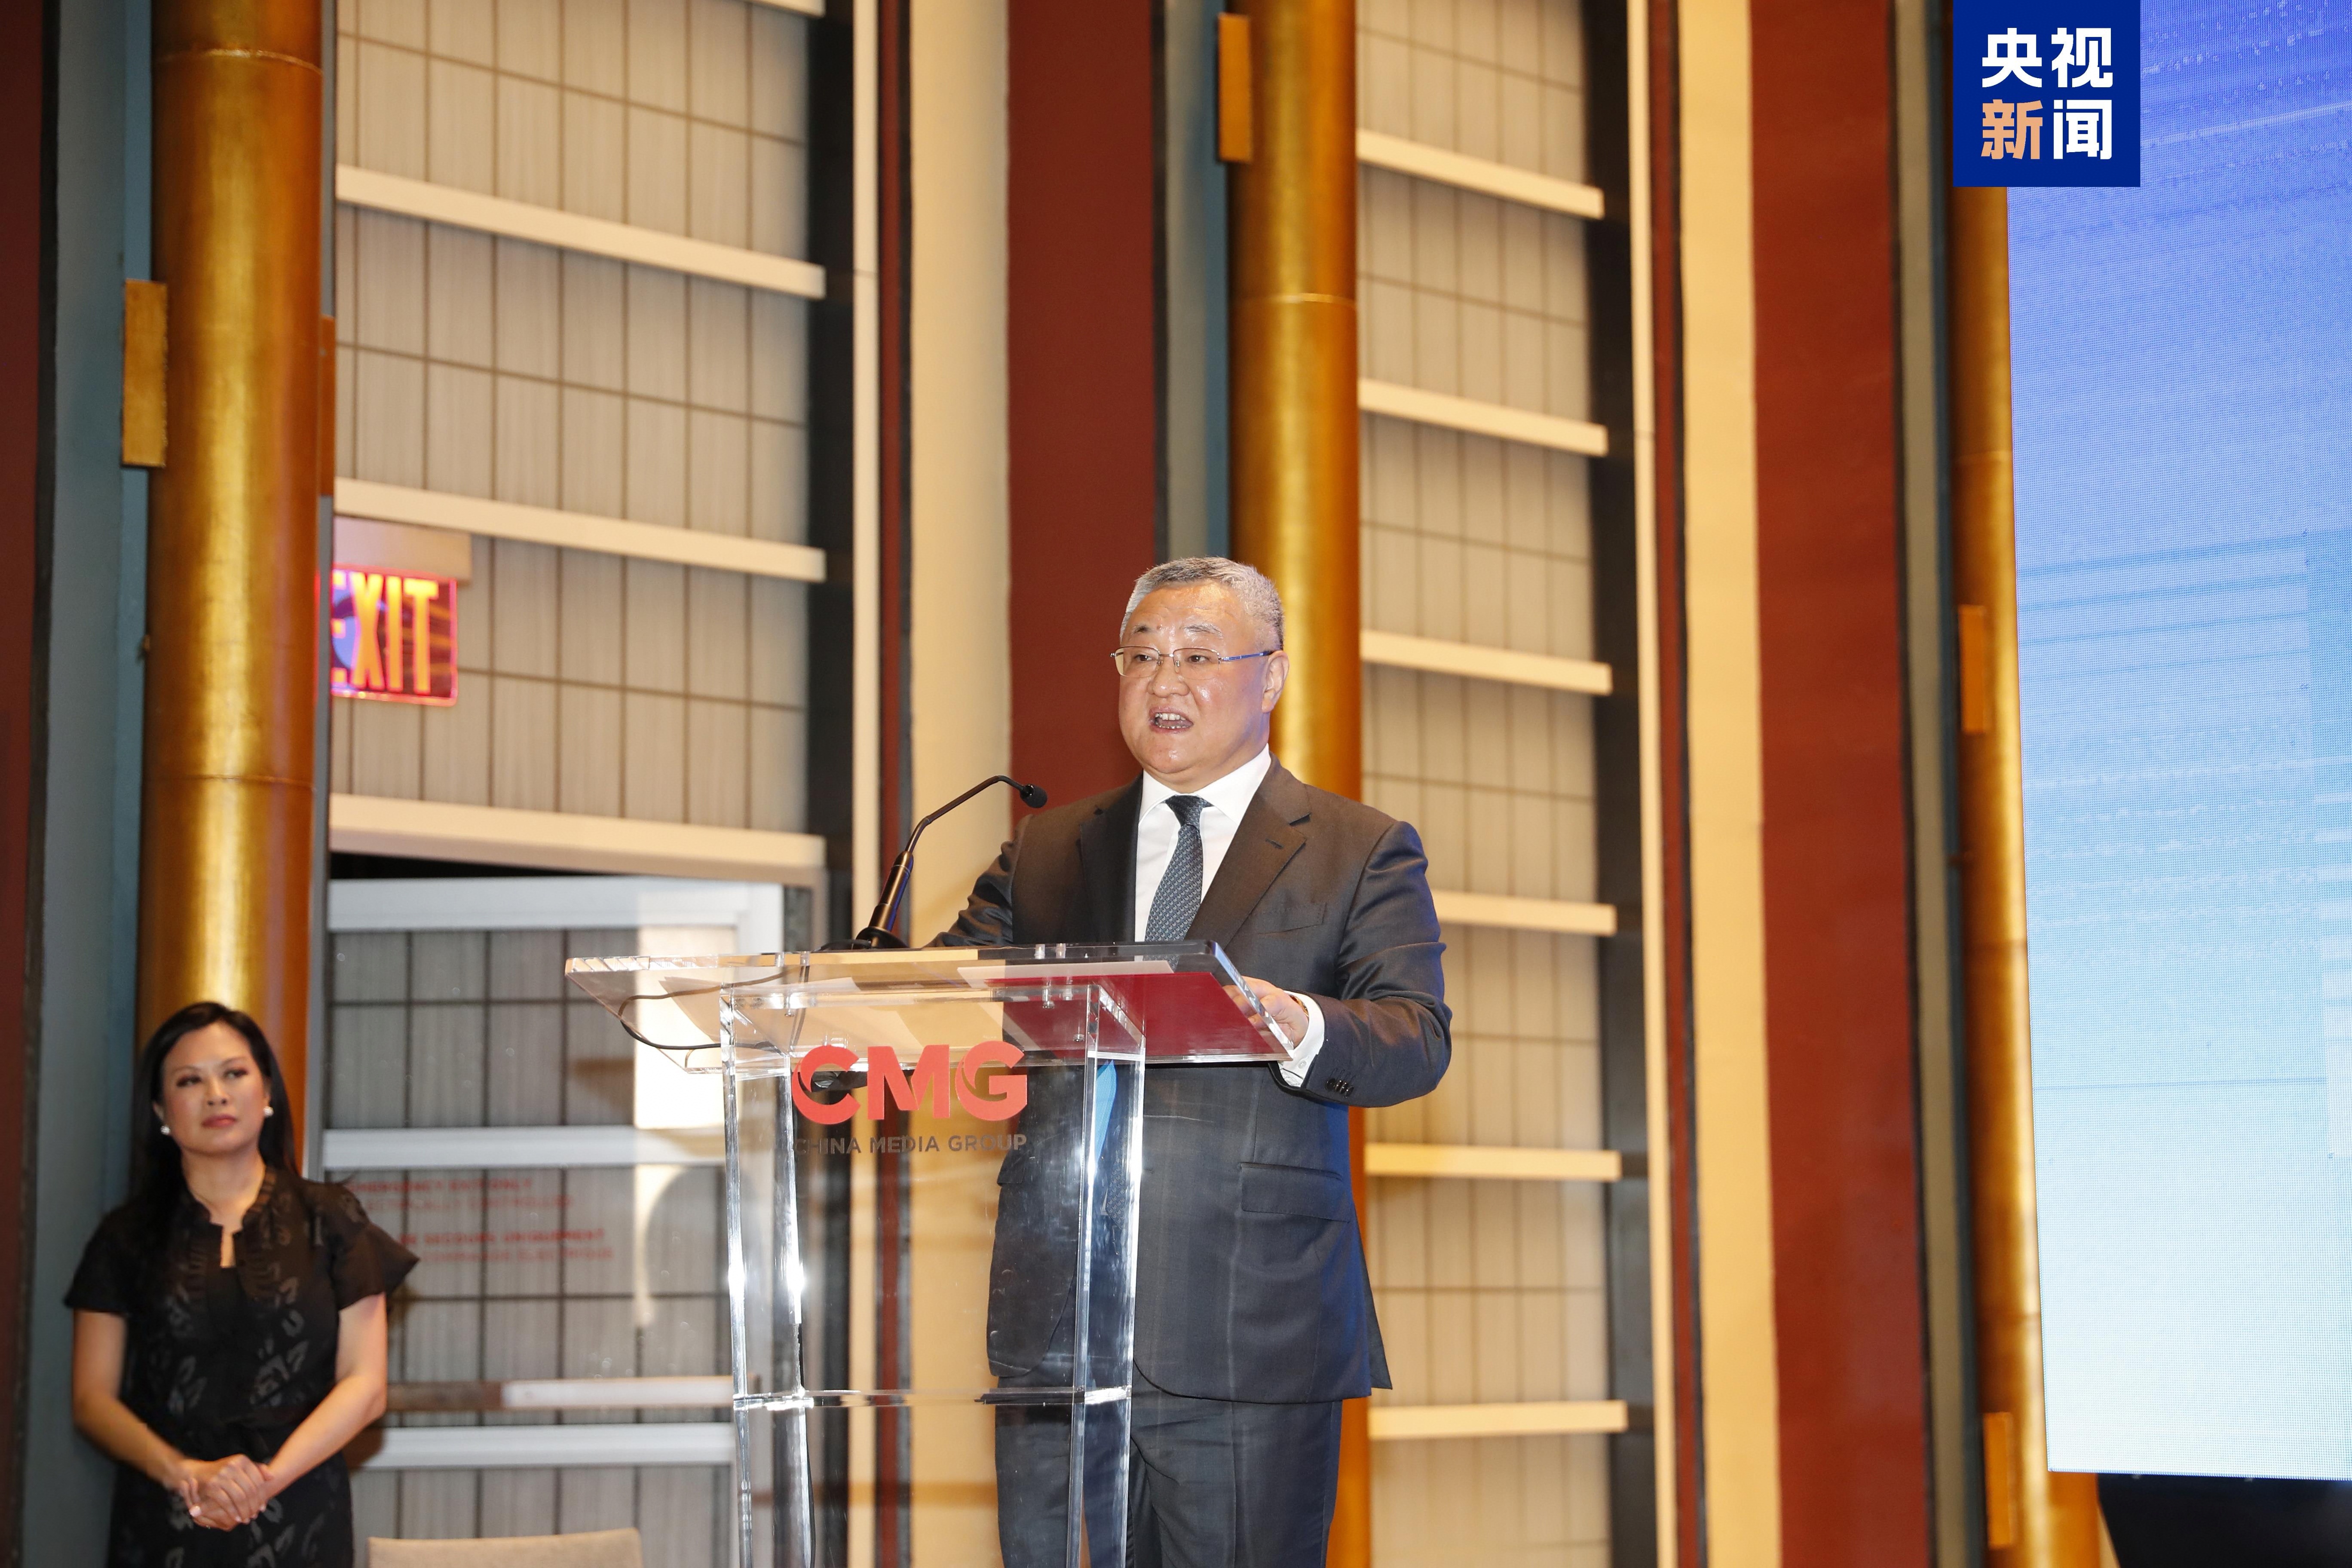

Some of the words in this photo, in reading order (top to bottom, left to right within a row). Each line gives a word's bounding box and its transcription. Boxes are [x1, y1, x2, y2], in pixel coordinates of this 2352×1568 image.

[791, 1040, 1027, 1124] CMG
[794, 1137, 861, 1155] CHINA
[870, 1135, 940, 1154] MEDIA
[948, 1134, 1027, 1152] GROUP
